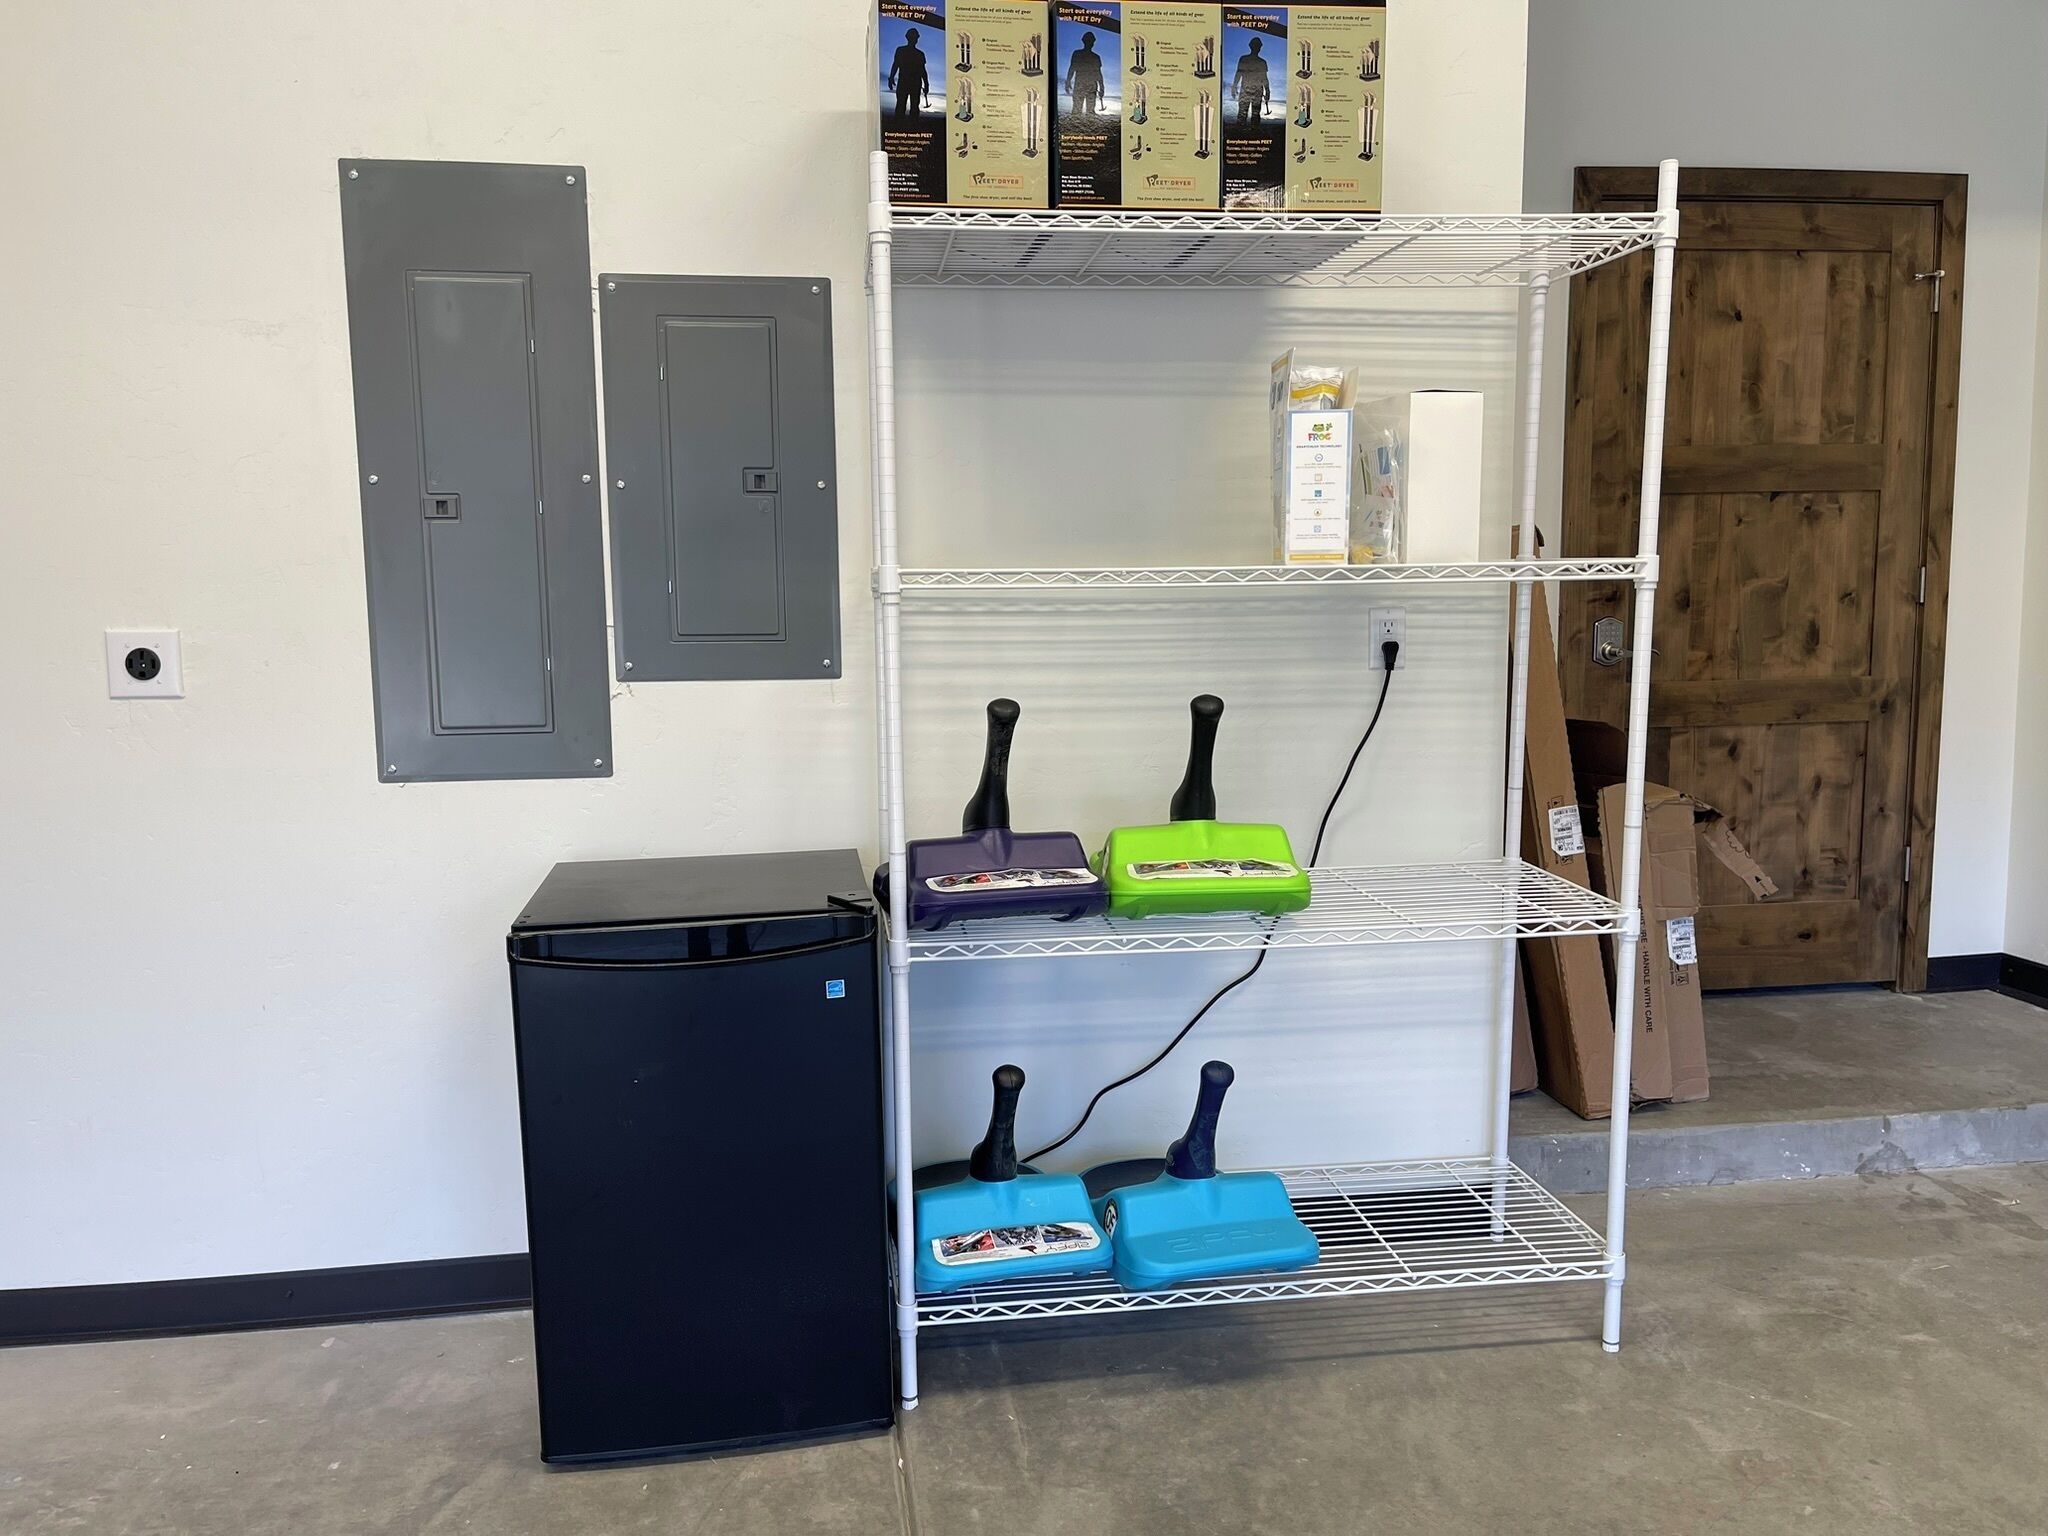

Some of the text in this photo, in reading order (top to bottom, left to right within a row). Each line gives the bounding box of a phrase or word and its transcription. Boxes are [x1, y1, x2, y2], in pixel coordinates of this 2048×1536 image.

[973, 172, 995, 185] PEET
[1308, 433, 1331, 441] FROG
[1642, 950, 1650, 985] HANDLE
